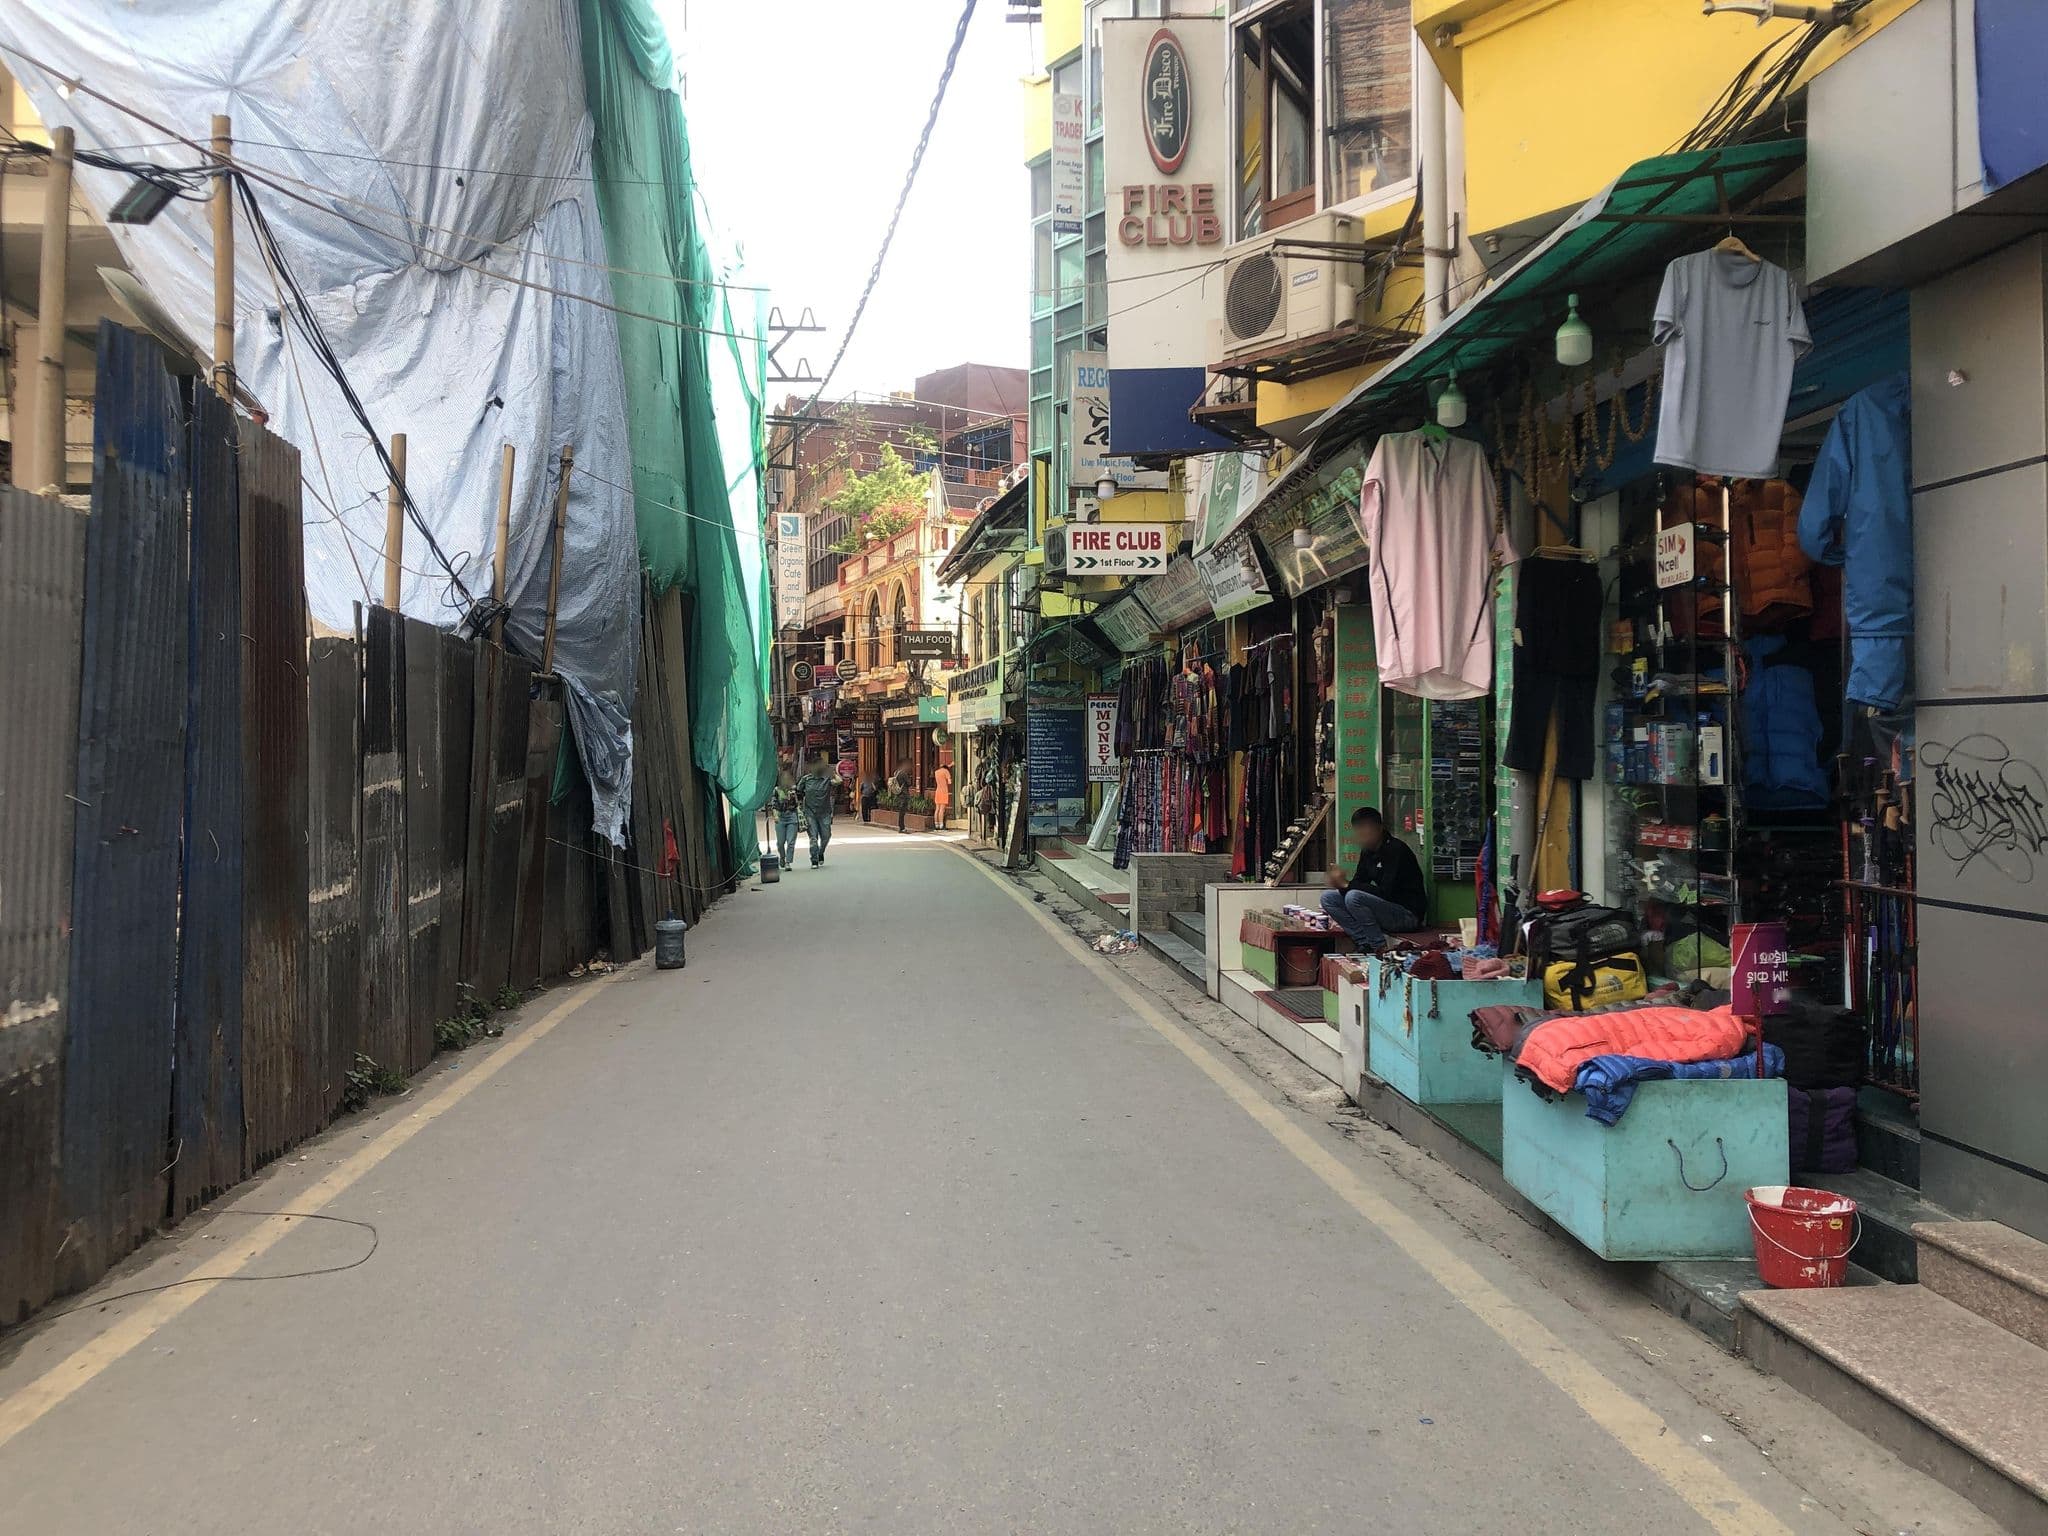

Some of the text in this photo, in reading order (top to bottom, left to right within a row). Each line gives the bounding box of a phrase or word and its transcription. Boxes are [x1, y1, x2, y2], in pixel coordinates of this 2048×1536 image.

[1152, 49, 1174, 138] Fire Disco
[1123, 184, 1216, 215] FIRE
[1119, 214, 1222, 246] CLUB
[782, 543, 803, 553] Green
[1072, 532, 1162, 550] FIRE CLUB
[1658, 533, 1677, 555] SIM
[780, 556, 804, 568] Organic
[1100, 558, 1136, 567] 1st Floor
[1658, 555, 1680, 574] Ncell
[787, 583, 800, 591] and
[903, 635, 951, 644] THAI FOOD
[1096, 710, 1112, 765] MONEY
[1089, 766, 1119, 776] EXCHANGE
